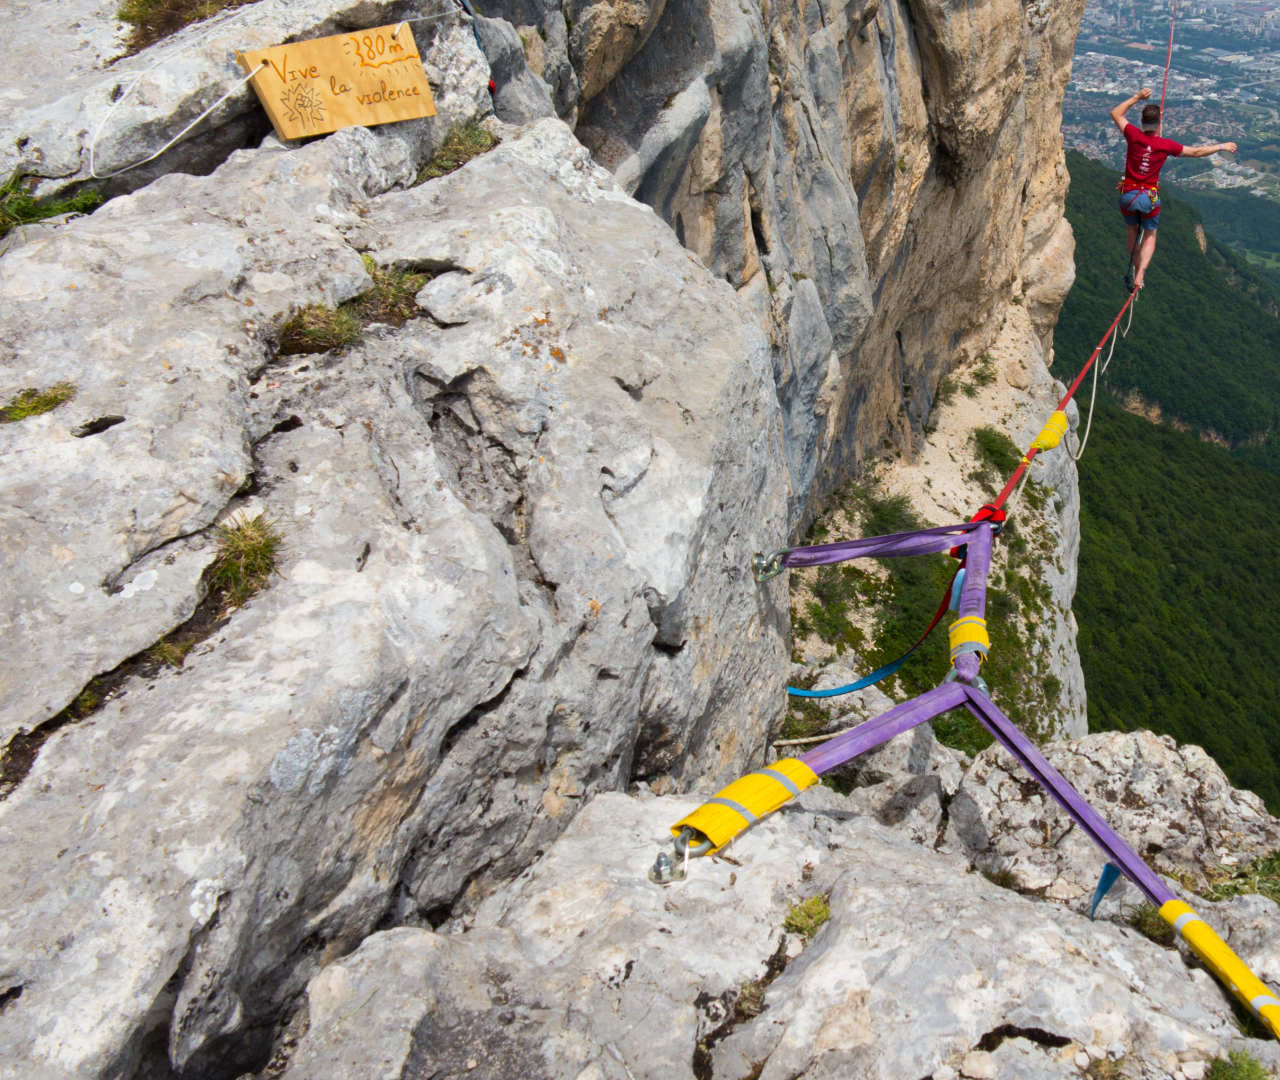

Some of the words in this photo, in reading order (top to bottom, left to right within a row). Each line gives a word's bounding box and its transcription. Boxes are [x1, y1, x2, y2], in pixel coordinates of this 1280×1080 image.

[270, 54, 320, 84] Vive
[329, 76, 351, 96] la
[356, 80, 421, 105] violence
